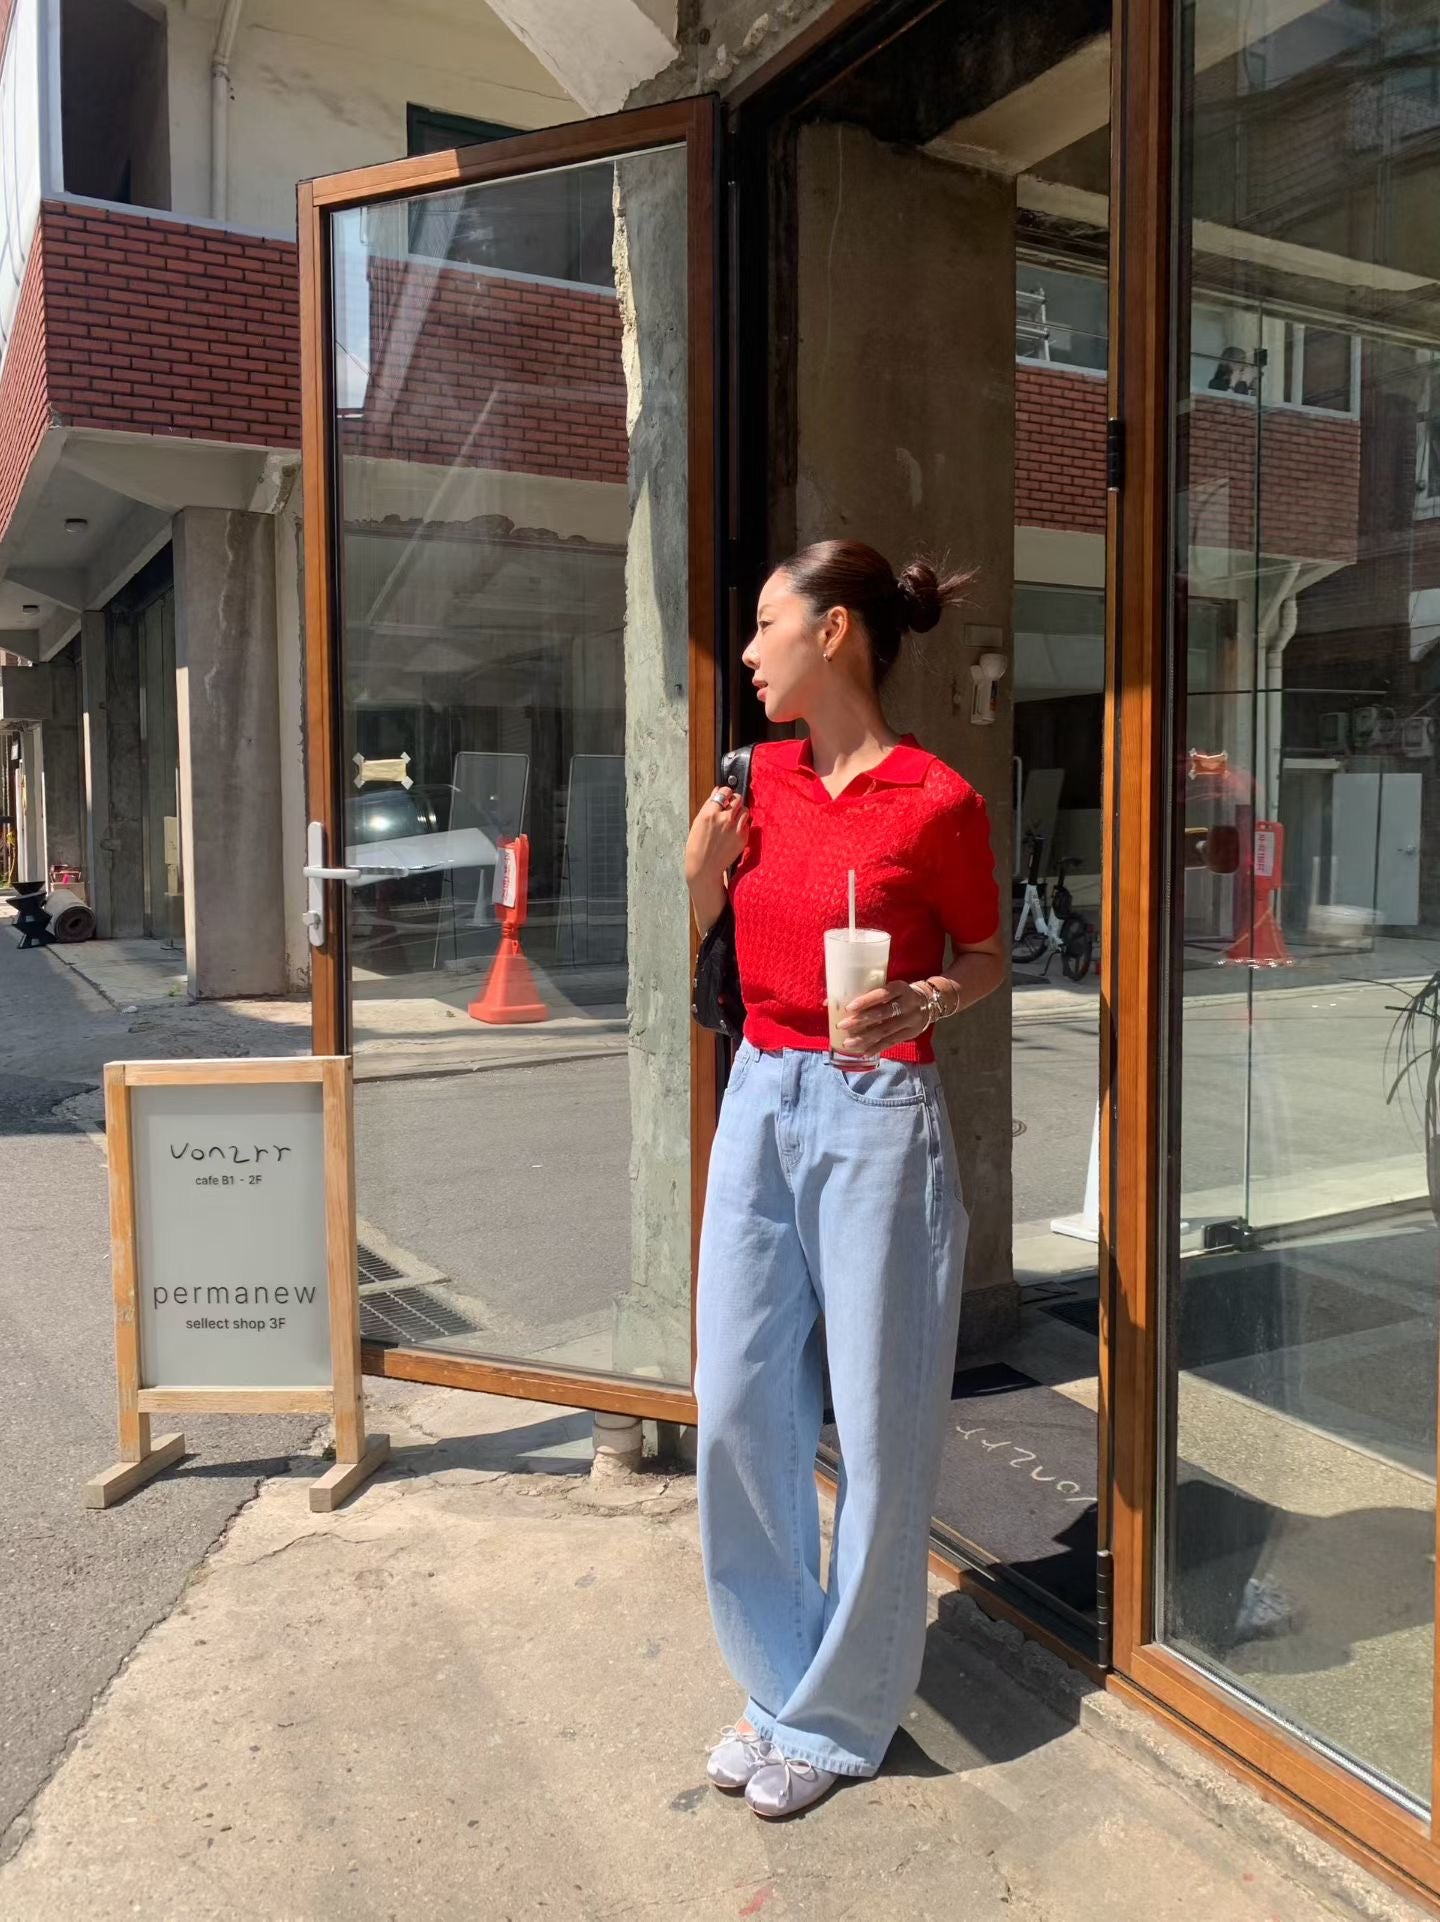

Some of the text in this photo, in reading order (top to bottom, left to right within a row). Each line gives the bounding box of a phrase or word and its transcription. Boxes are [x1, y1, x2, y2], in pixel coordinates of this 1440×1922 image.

[195, 1175, 219, 1185] cafe
[221, 1175, 234, 1185] B1
[248, 1174, 263, 1185] 2F
[153, 1285, 317, 1309] permanew
[233, 1317, 266, 1332] shop
[269, 1317, 286, 1329] 3F
